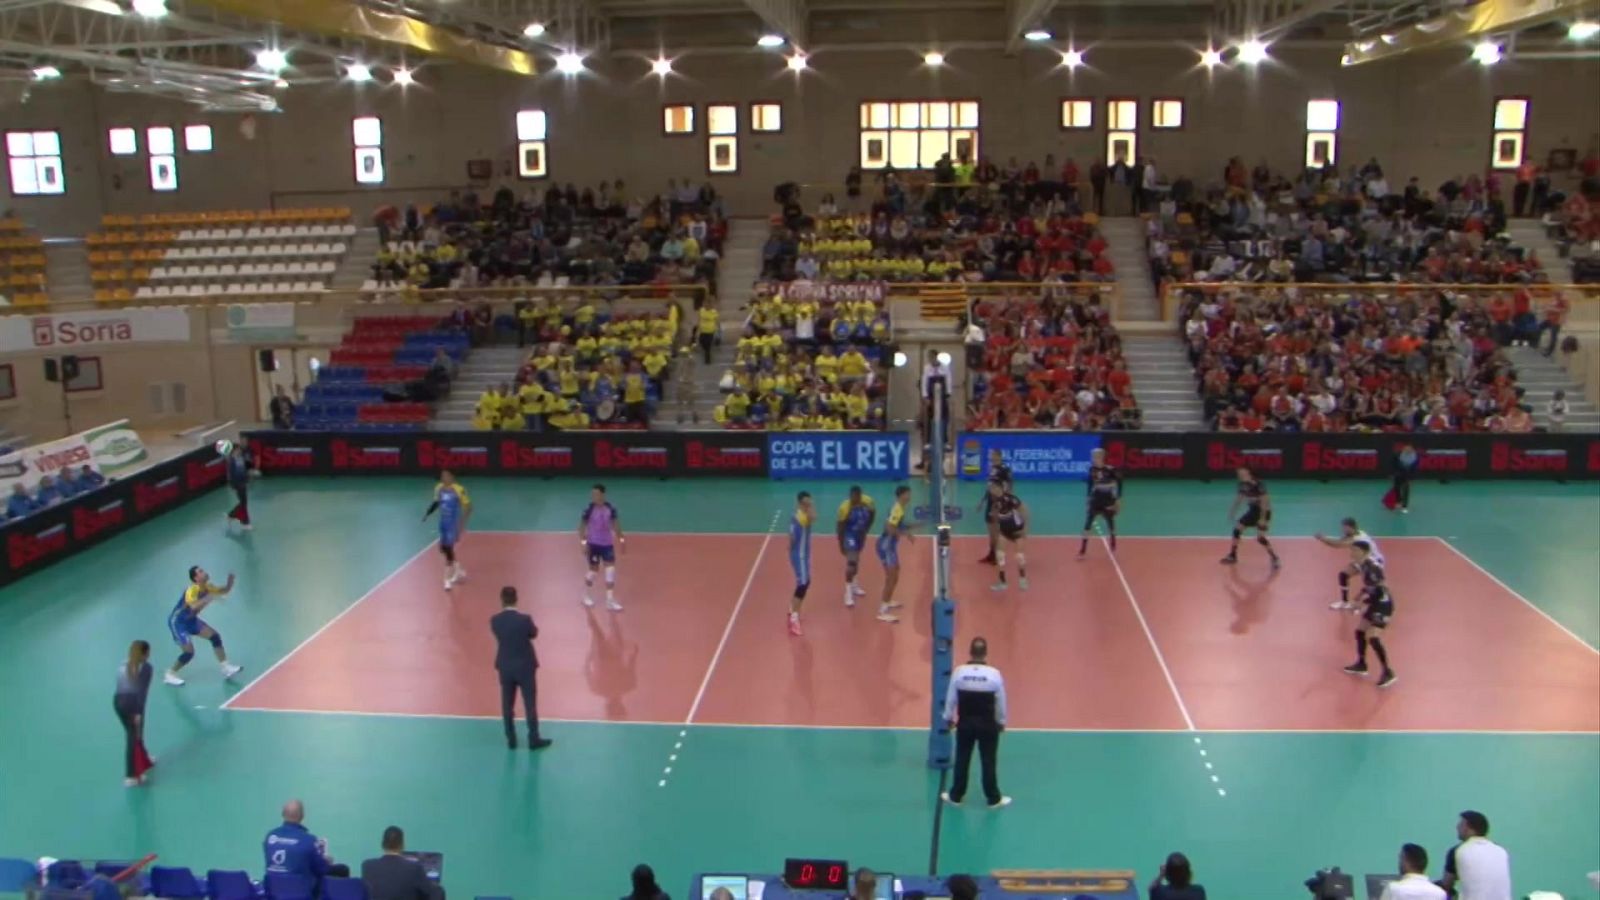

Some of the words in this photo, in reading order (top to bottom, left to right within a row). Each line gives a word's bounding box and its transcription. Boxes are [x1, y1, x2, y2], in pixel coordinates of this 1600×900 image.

[58, 320, 132, 344] Soria
[771, 441, 815, 454] COPA
[821, 441, 850, 470] EL
[857, 441, 905, 470] REY
[771, 458, 787, 469] DE
[801, 864, 813, 881] 0
[828, 865, 842, 883] 0
